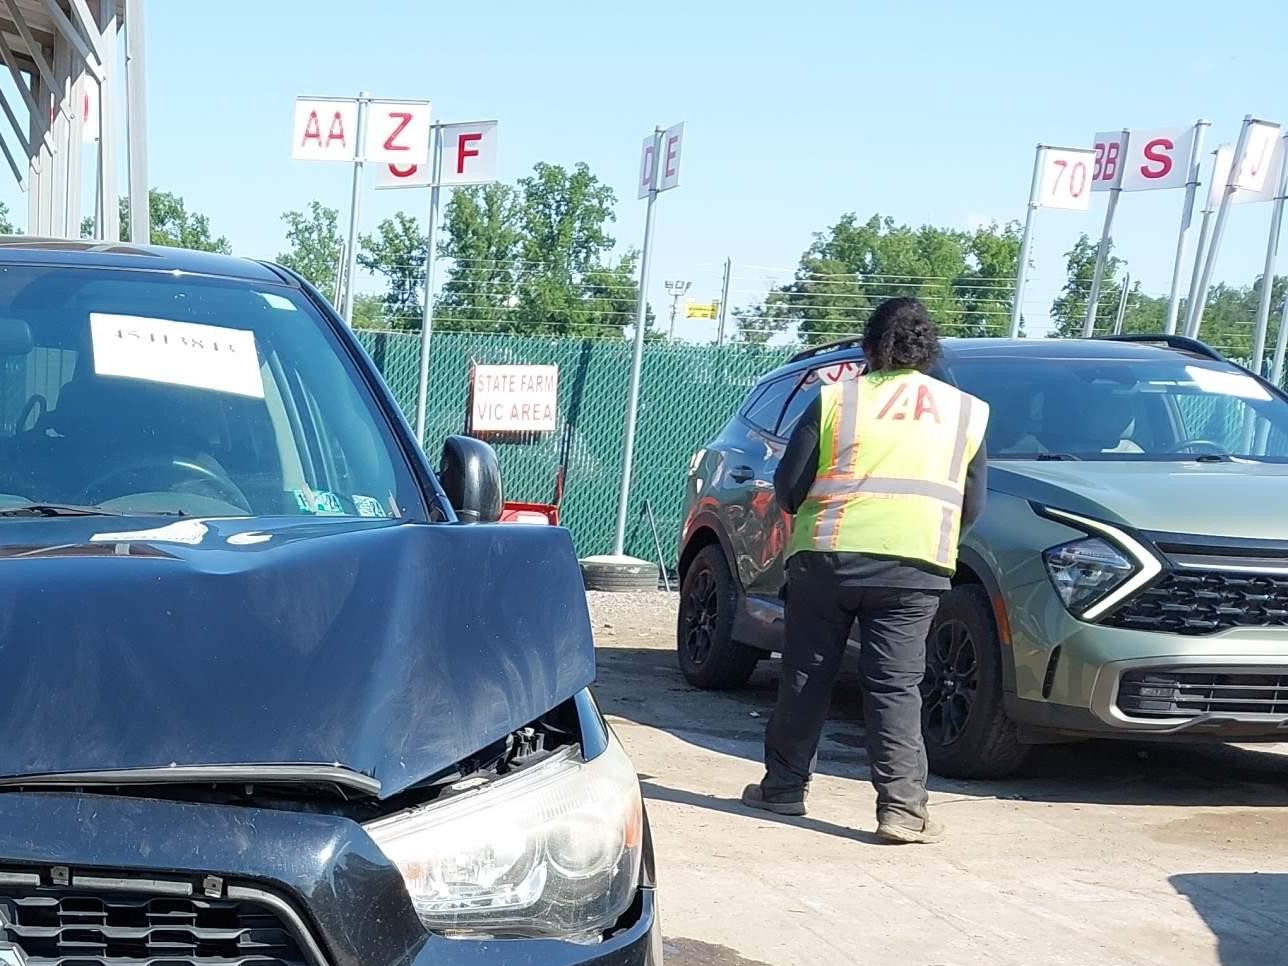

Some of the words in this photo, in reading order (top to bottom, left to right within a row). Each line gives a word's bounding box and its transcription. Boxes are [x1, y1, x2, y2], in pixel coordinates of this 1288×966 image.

[301, 110, 347, 148] AA
[382, 111, 414, 151] Z
[456, 132, 482, 174] F
[665, 135, 679, 178] E
[1092, 142, 1120, 181] BB
[1140, 138, 1174, 179] S
[1052, 159, 1087, 198] 70
[477, 374, 516, 393] STATE
[477, 403, 504, 421] VIC
[510, 403, 553, 421] AREA
